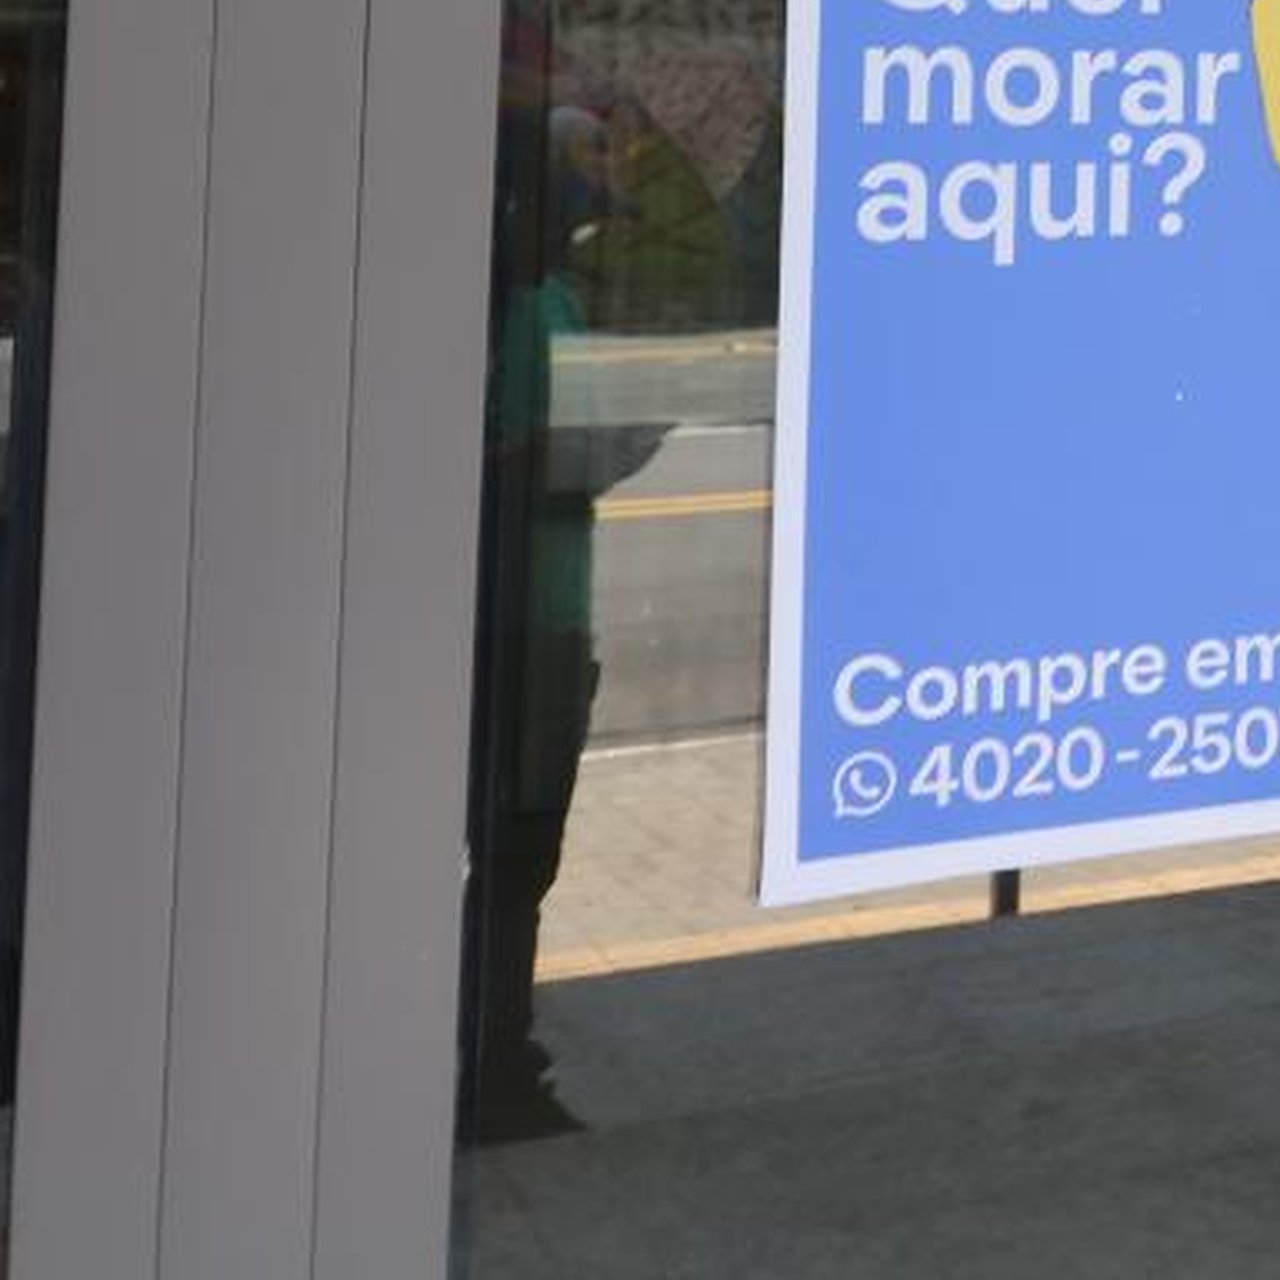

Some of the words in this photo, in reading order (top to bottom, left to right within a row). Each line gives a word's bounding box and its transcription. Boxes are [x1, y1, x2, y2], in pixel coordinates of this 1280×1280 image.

[864, 45, 1239, 126] morar
[858, 132, 1205, 265] aqui?
[834, 647, 1166, 723] Compre
